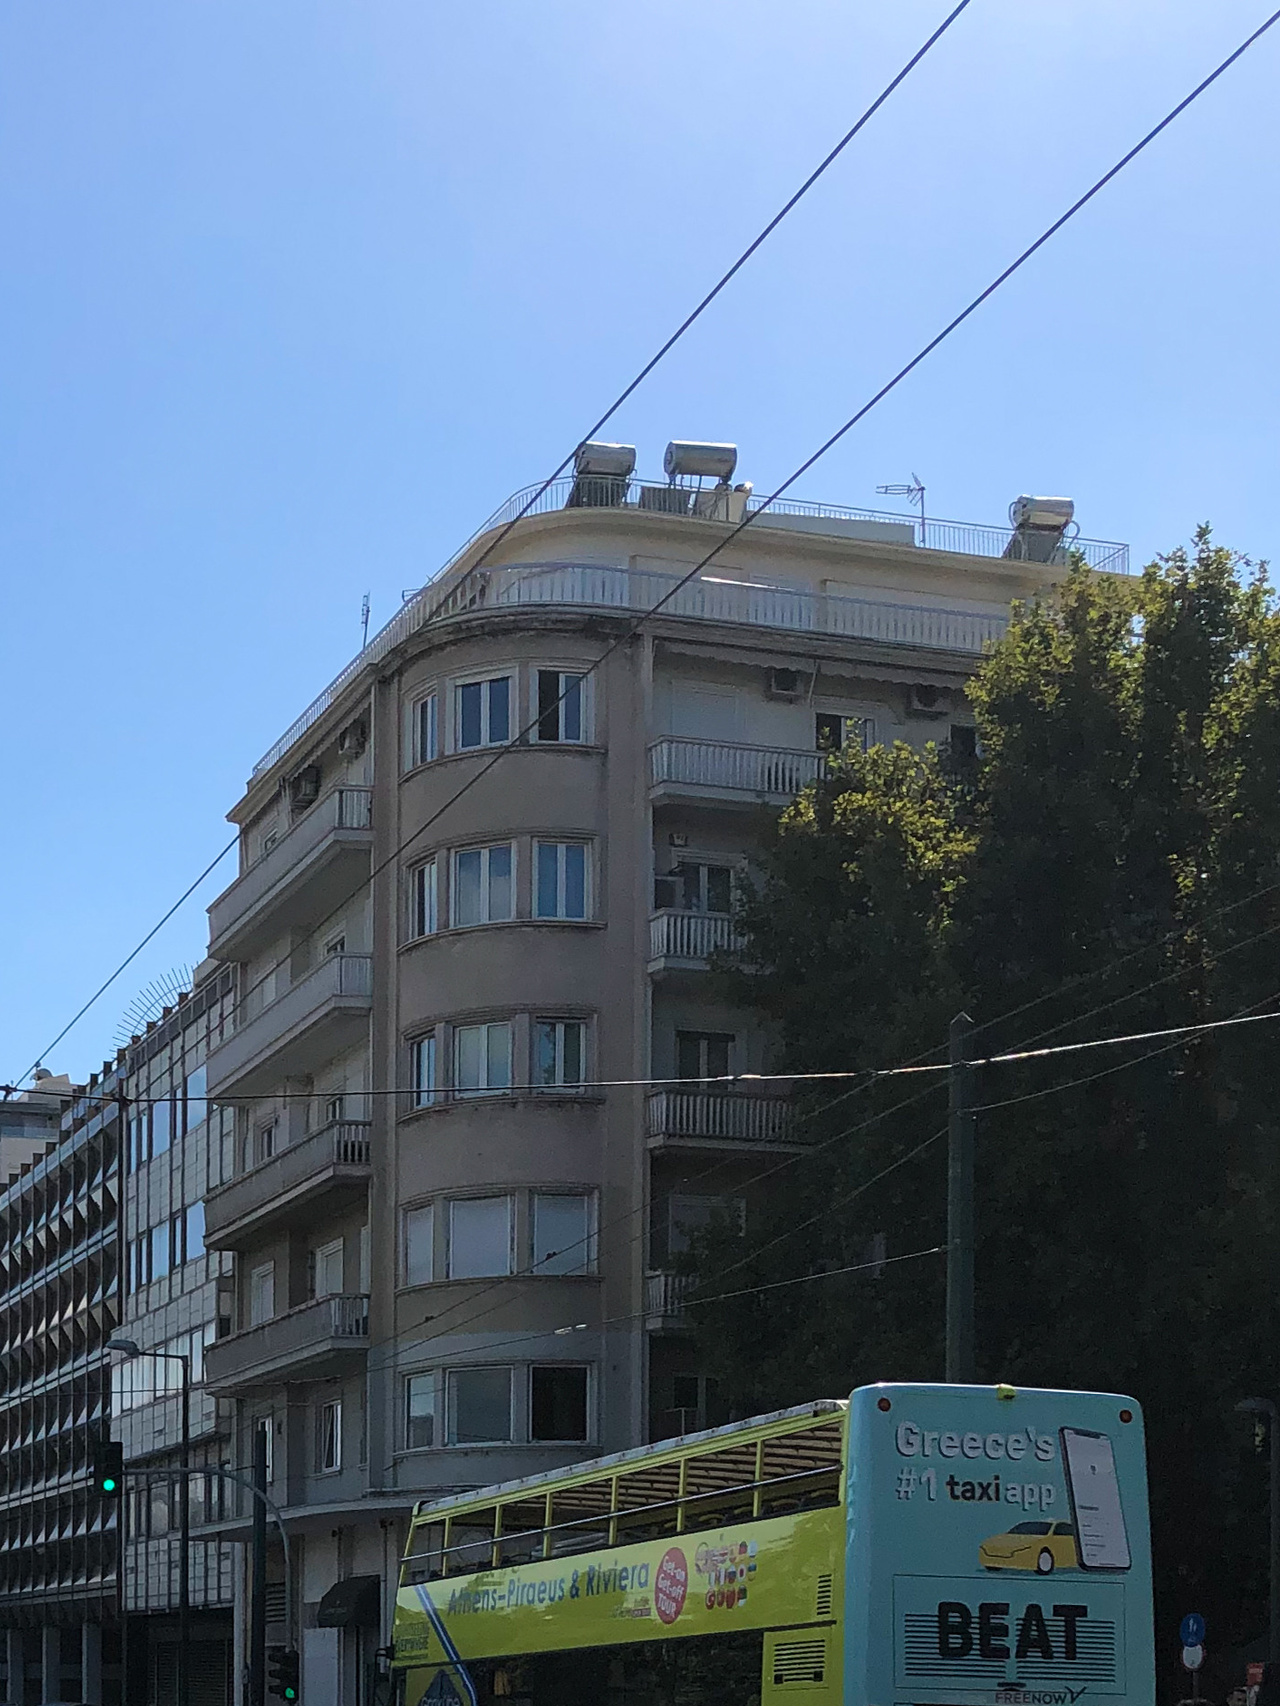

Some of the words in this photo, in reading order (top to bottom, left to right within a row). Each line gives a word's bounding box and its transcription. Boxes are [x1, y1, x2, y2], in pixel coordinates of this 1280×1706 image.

[895, 1420, 1056, 1462] Greece's
[894, 1467, 938, 1502] #1
[946, 1474, 1002, 1502] taxi
[1006, 1479, 1056, 1512] app
[569, 1568, 580, 1600] &
[586, 1560, 651, 1597] Riviera
[657, 1574, 685, 1601] Get-off
[662, 1555, 686, 1582] Get-on
[657, 1593, 677, 1618] TOUR
[936, 1600, 1089, 1661] BEAT
